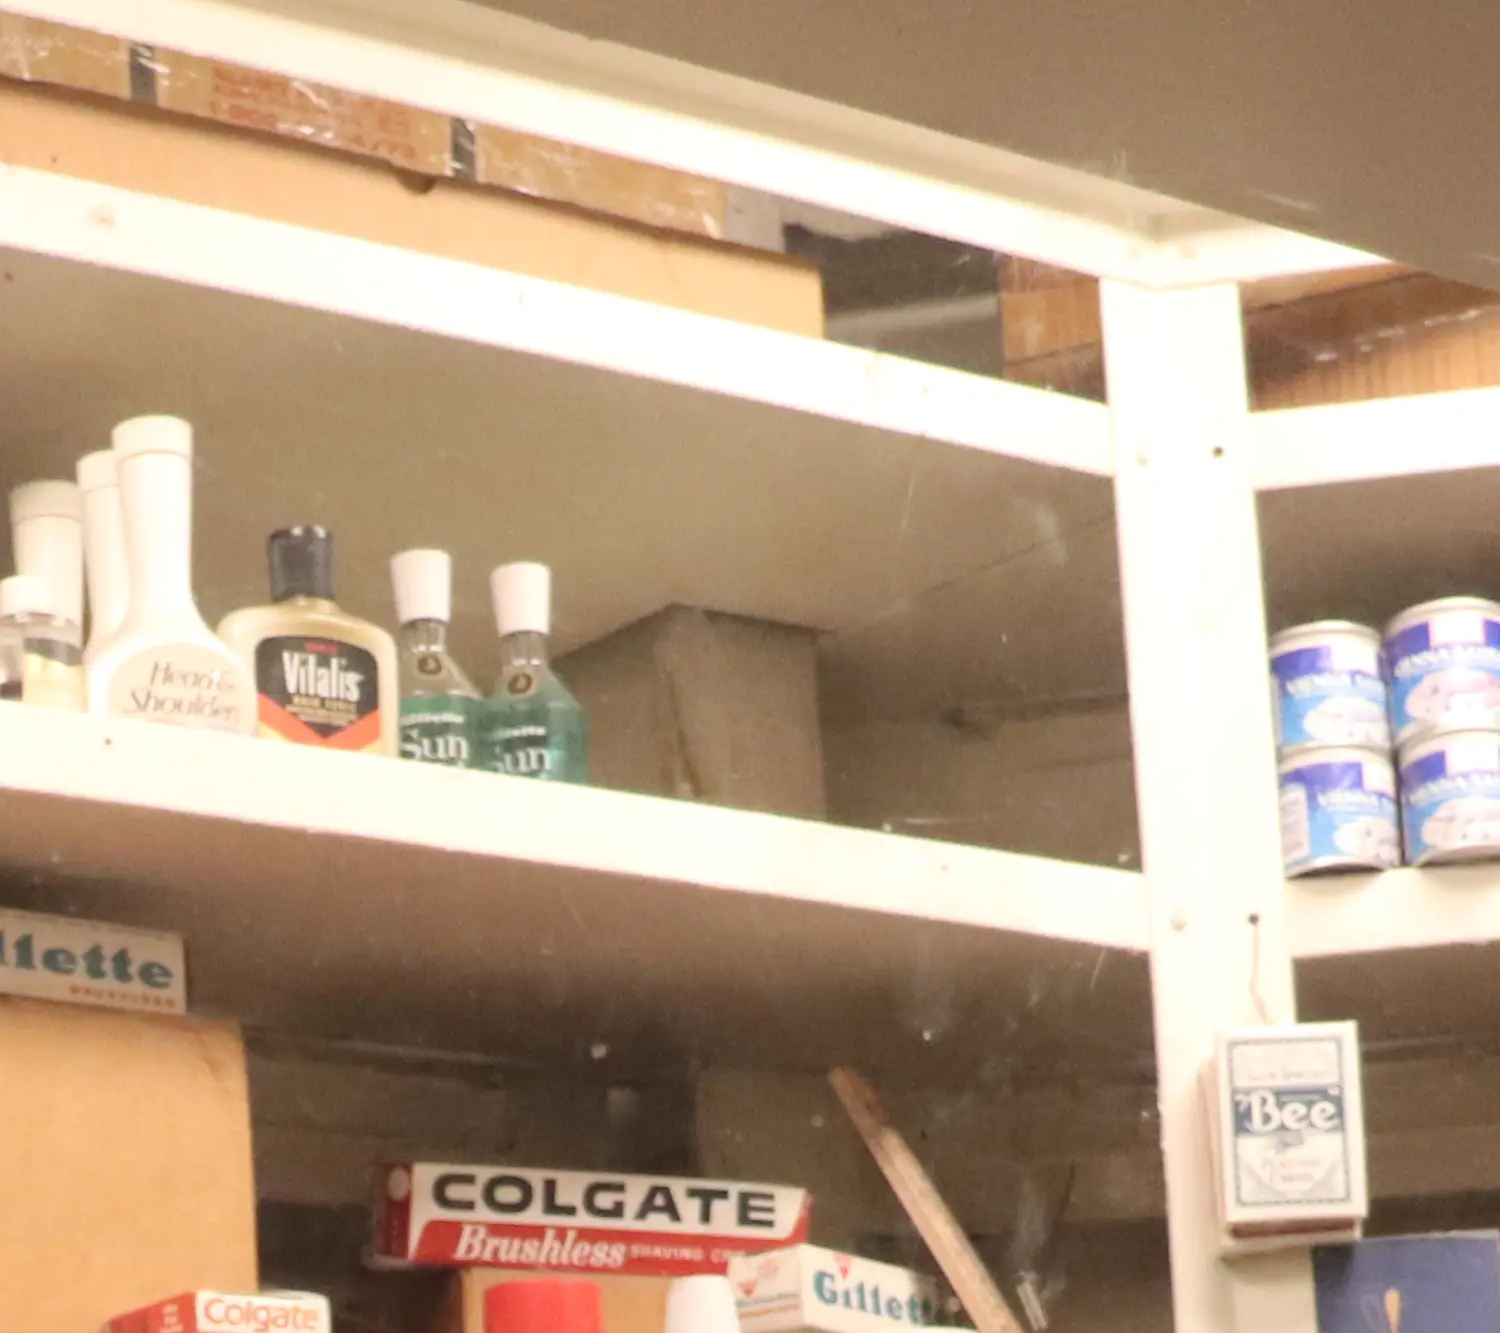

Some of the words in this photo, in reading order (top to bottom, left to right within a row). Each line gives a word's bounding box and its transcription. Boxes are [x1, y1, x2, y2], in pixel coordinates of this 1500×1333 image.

[281, 650, 365, 703] Vitalis
[1246, 1087, 1338, 1132] Bee
[432, 1171, 777, 1230] COLGATE
[454, 1221, 626, 1267] Brushless
[203, 1297, 320, 1333] Colgate
